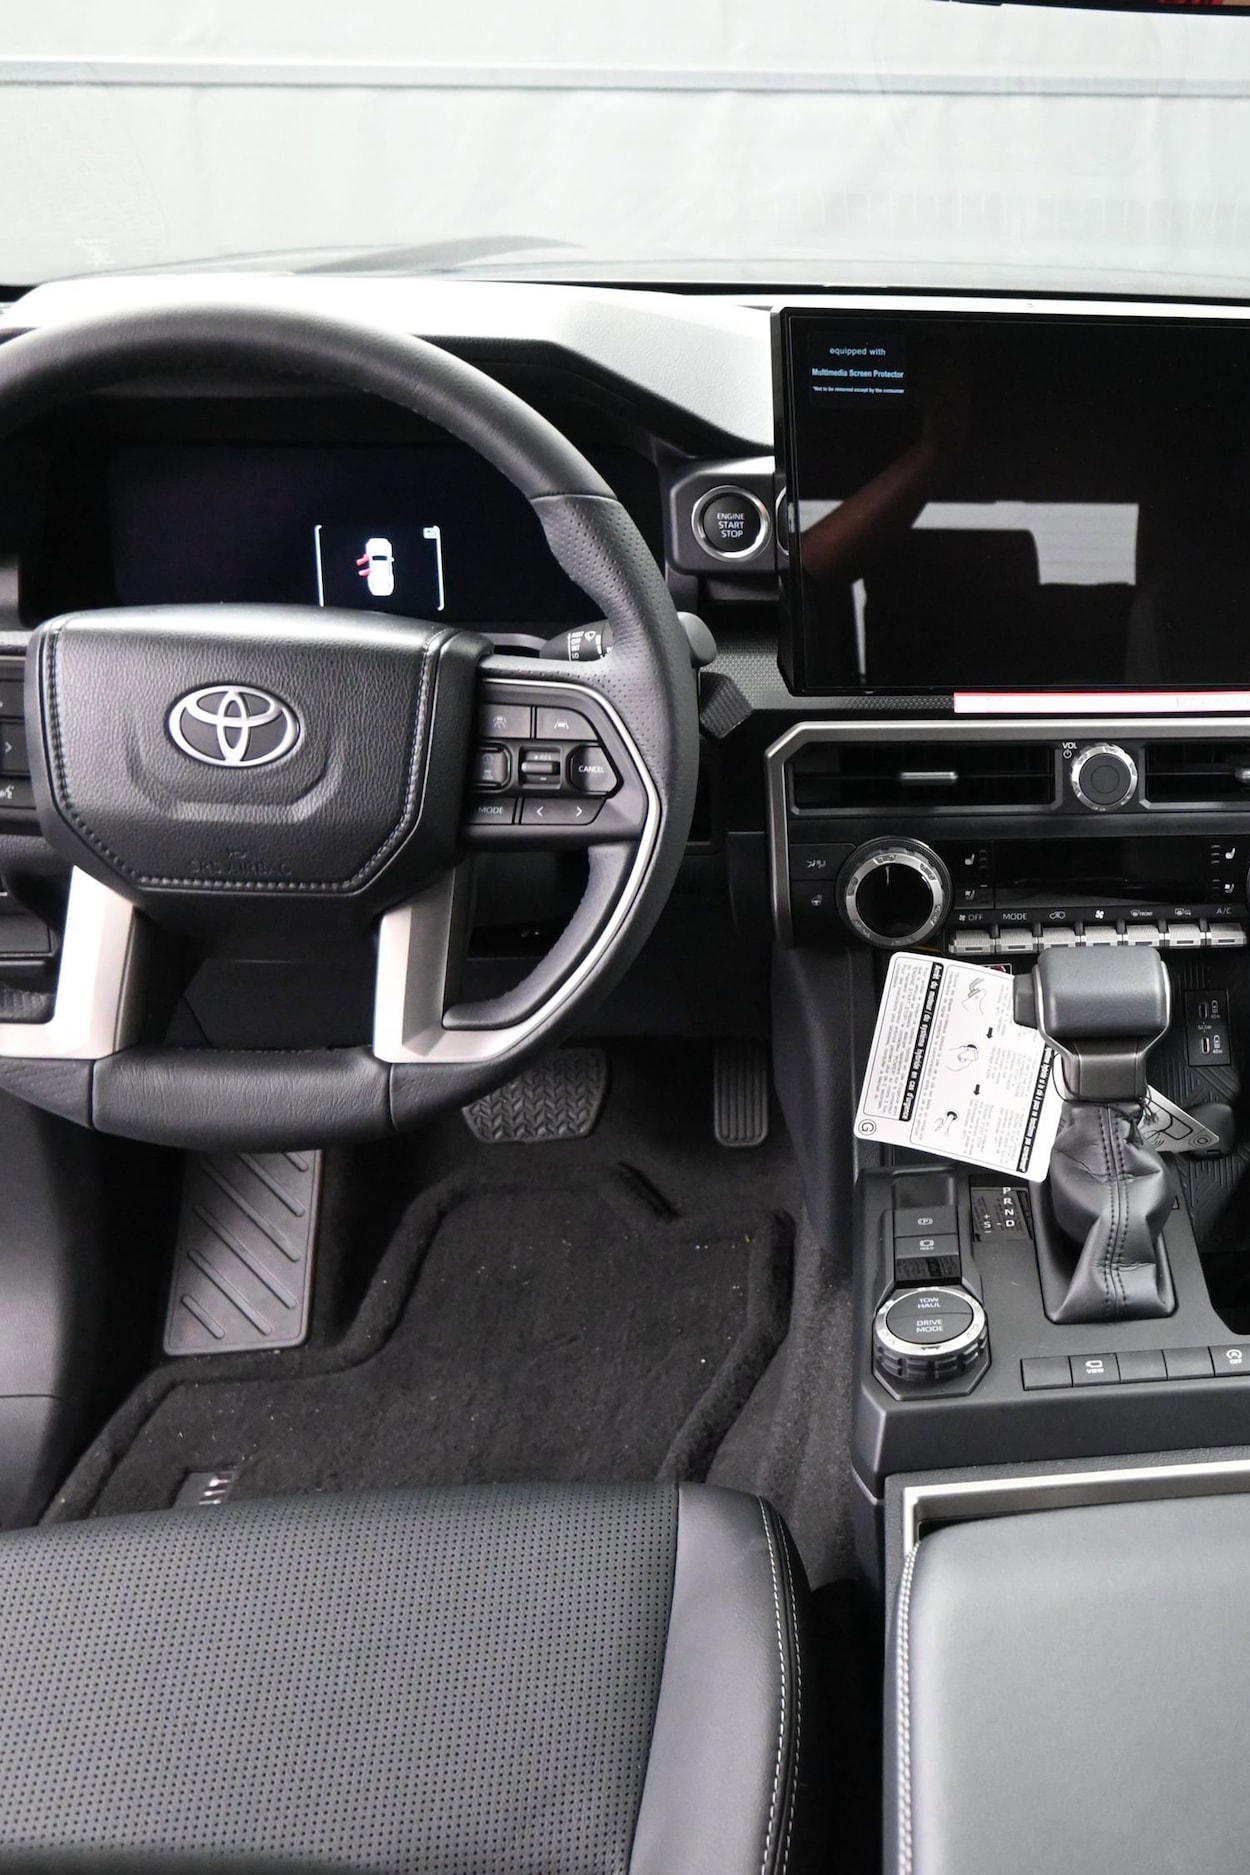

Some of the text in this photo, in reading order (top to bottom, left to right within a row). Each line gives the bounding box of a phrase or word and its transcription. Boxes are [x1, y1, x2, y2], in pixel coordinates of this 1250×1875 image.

[829, 347, 886, 356] equipped with
[811, 368, 904, 378] Multimedia Screen Protector
[716, 512, 745, 520] ENGINE
[718, 521, 744, 529] START
[721, 530, 743, 538] STOP
[1062, 741, 1078, 749] VOL
[578, 764, 604, 774] CANCEL
[478, 806, 504, 814] MODE
[1216, 907, 1232, 915] A/C
[968, 913, 984, 921] OFF
[1003, 912, 1027, 920] MODE
[930, 980, 938, 989] du
[911, 1047, 924, 1069] hybride
[910, 1070, 918, 1079] en
[908, 1079, 916, 1091] cas
[1002, 1187, 1011, 1195] P
[983, 1220, 1015, 1229] S D
